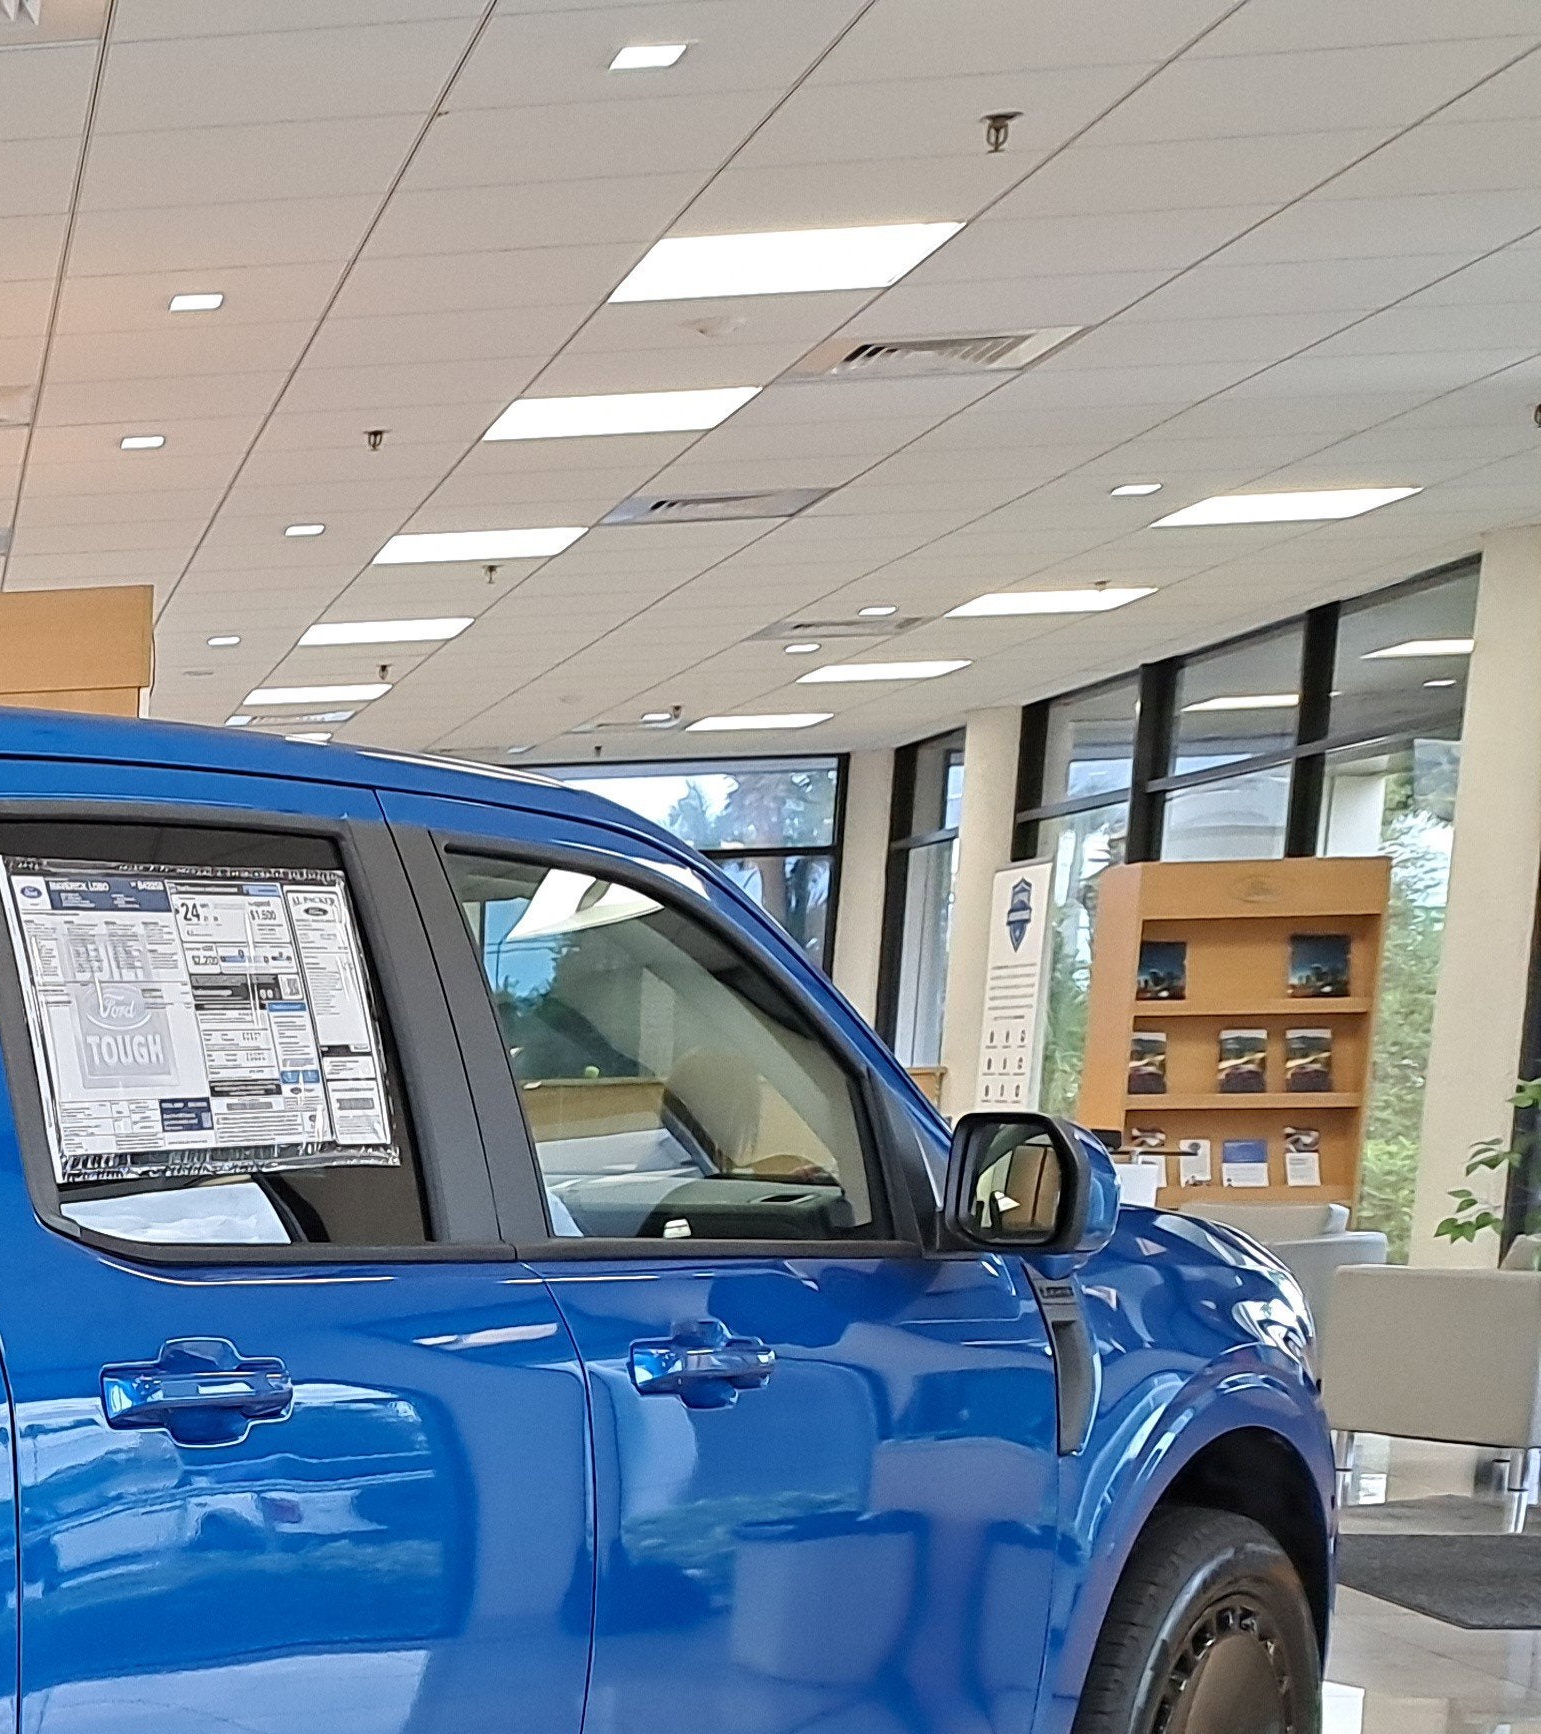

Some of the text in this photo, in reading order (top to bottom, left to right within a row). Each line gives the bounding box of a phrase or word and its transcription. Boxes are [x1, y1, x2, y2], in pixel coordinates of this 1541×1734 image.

[180, 903, 201, 922] 24
[101, 993, 136, 1019] Ford
[86, 1033, 165, 1067] TOUGH
